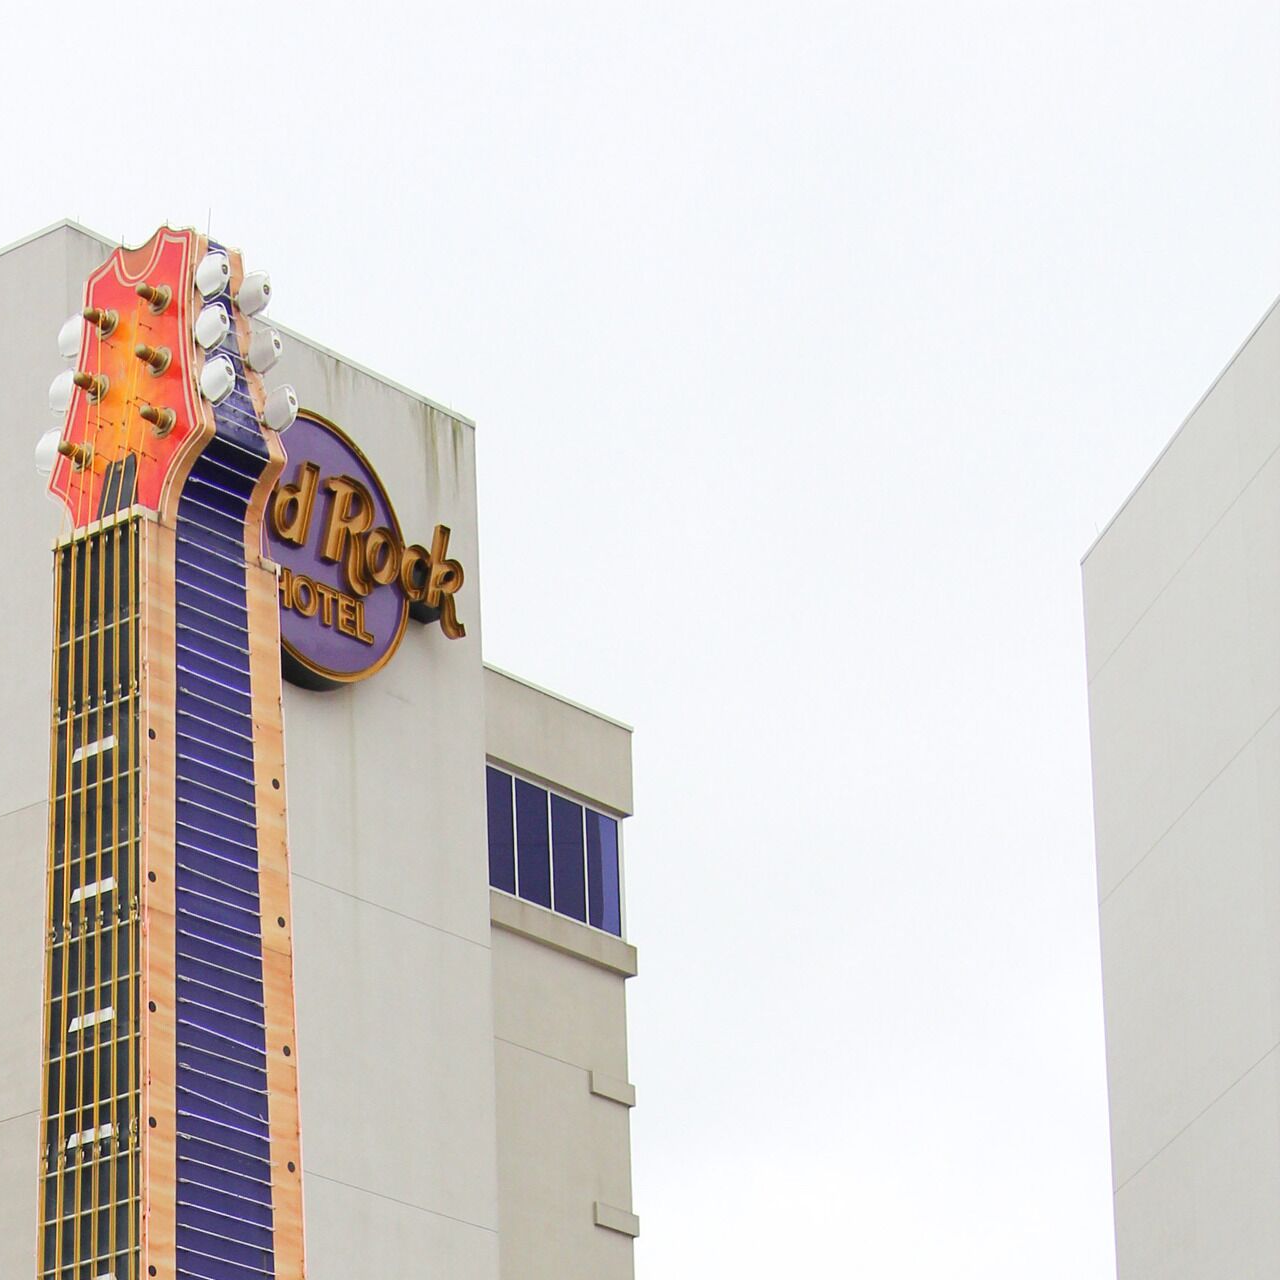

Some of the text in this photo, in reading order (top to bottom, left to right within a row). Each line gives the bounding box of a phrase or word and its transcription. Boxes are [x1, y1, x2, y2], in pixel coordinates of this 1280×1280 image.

[271, 461, 466, 640] d Rock
[279, 567, 375, 645] HOTEL
